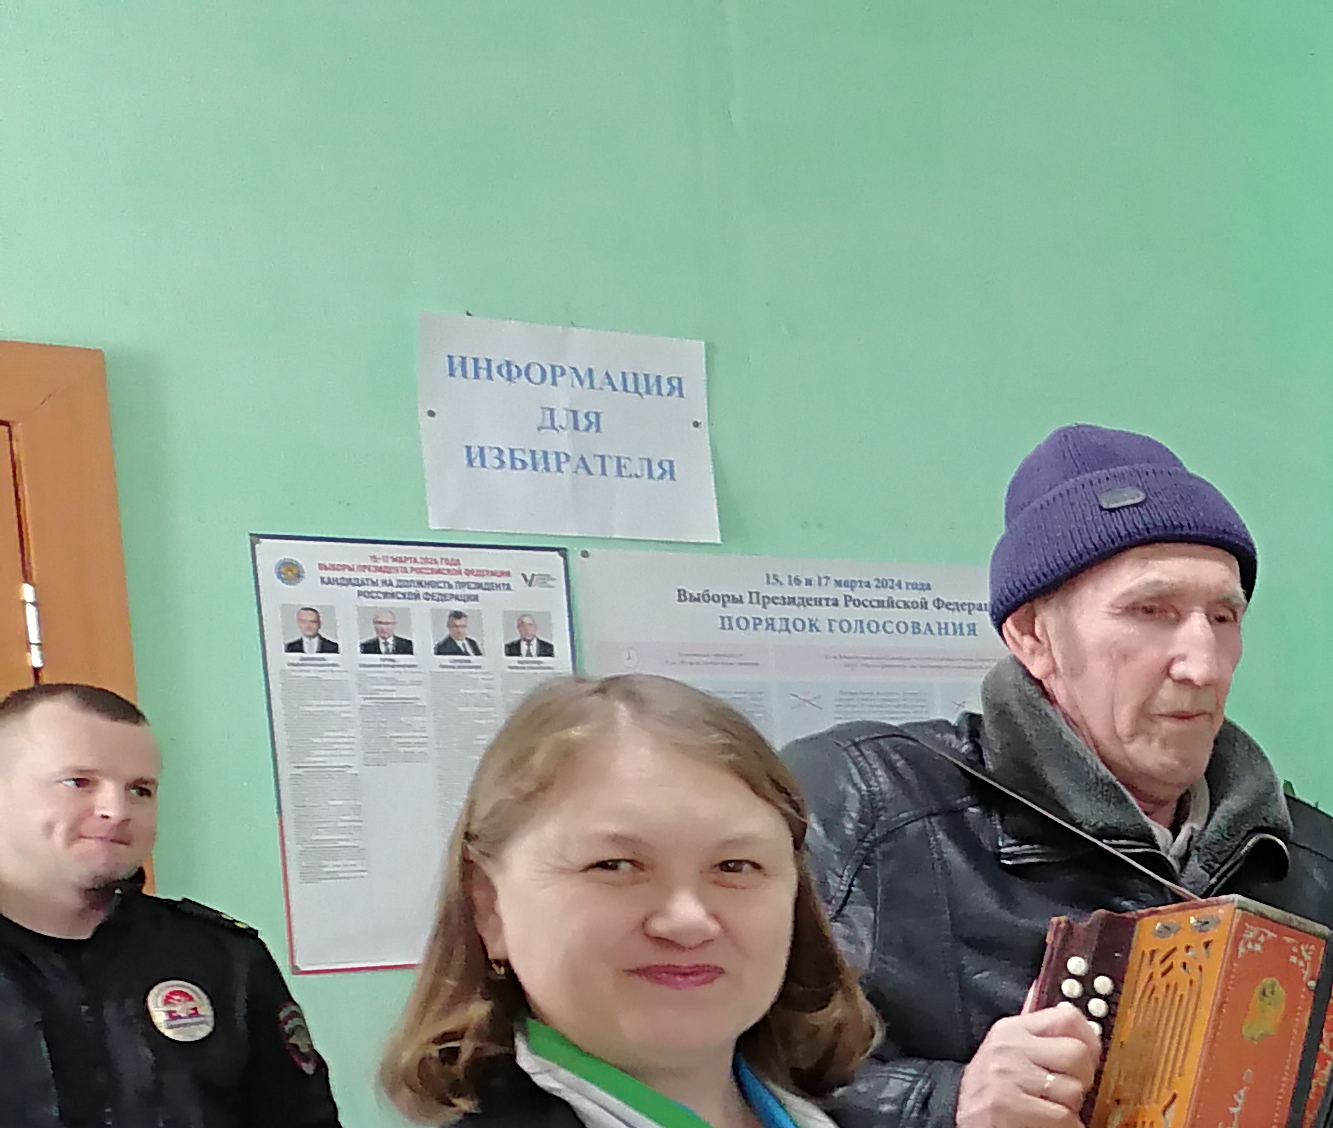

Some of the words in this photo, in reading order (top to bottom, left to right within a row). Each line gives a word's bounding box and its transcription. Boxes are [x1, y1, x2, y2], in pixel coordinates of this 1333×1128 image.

[447, 354, 686, 399] ИНФОРМАЦИЯ
[537, 405, 604, 434] ДЛЯ
[465, 444, 678, 482] ИЗБИРАТЕЛЯ
[787, 574, 801, 587] 16
[817, 575, 831, 588] 17
[874, 578, 900, 590] 2024
[676, 588, 744, 607] Выборы
[748, 591, 839, 611] Президента
[843, 594, 928, 611] Российской
[719, 614, 821, 634] ПОРЯДОК
[827, 618, 978, 637] ГОЛОСОВАНИЯ
